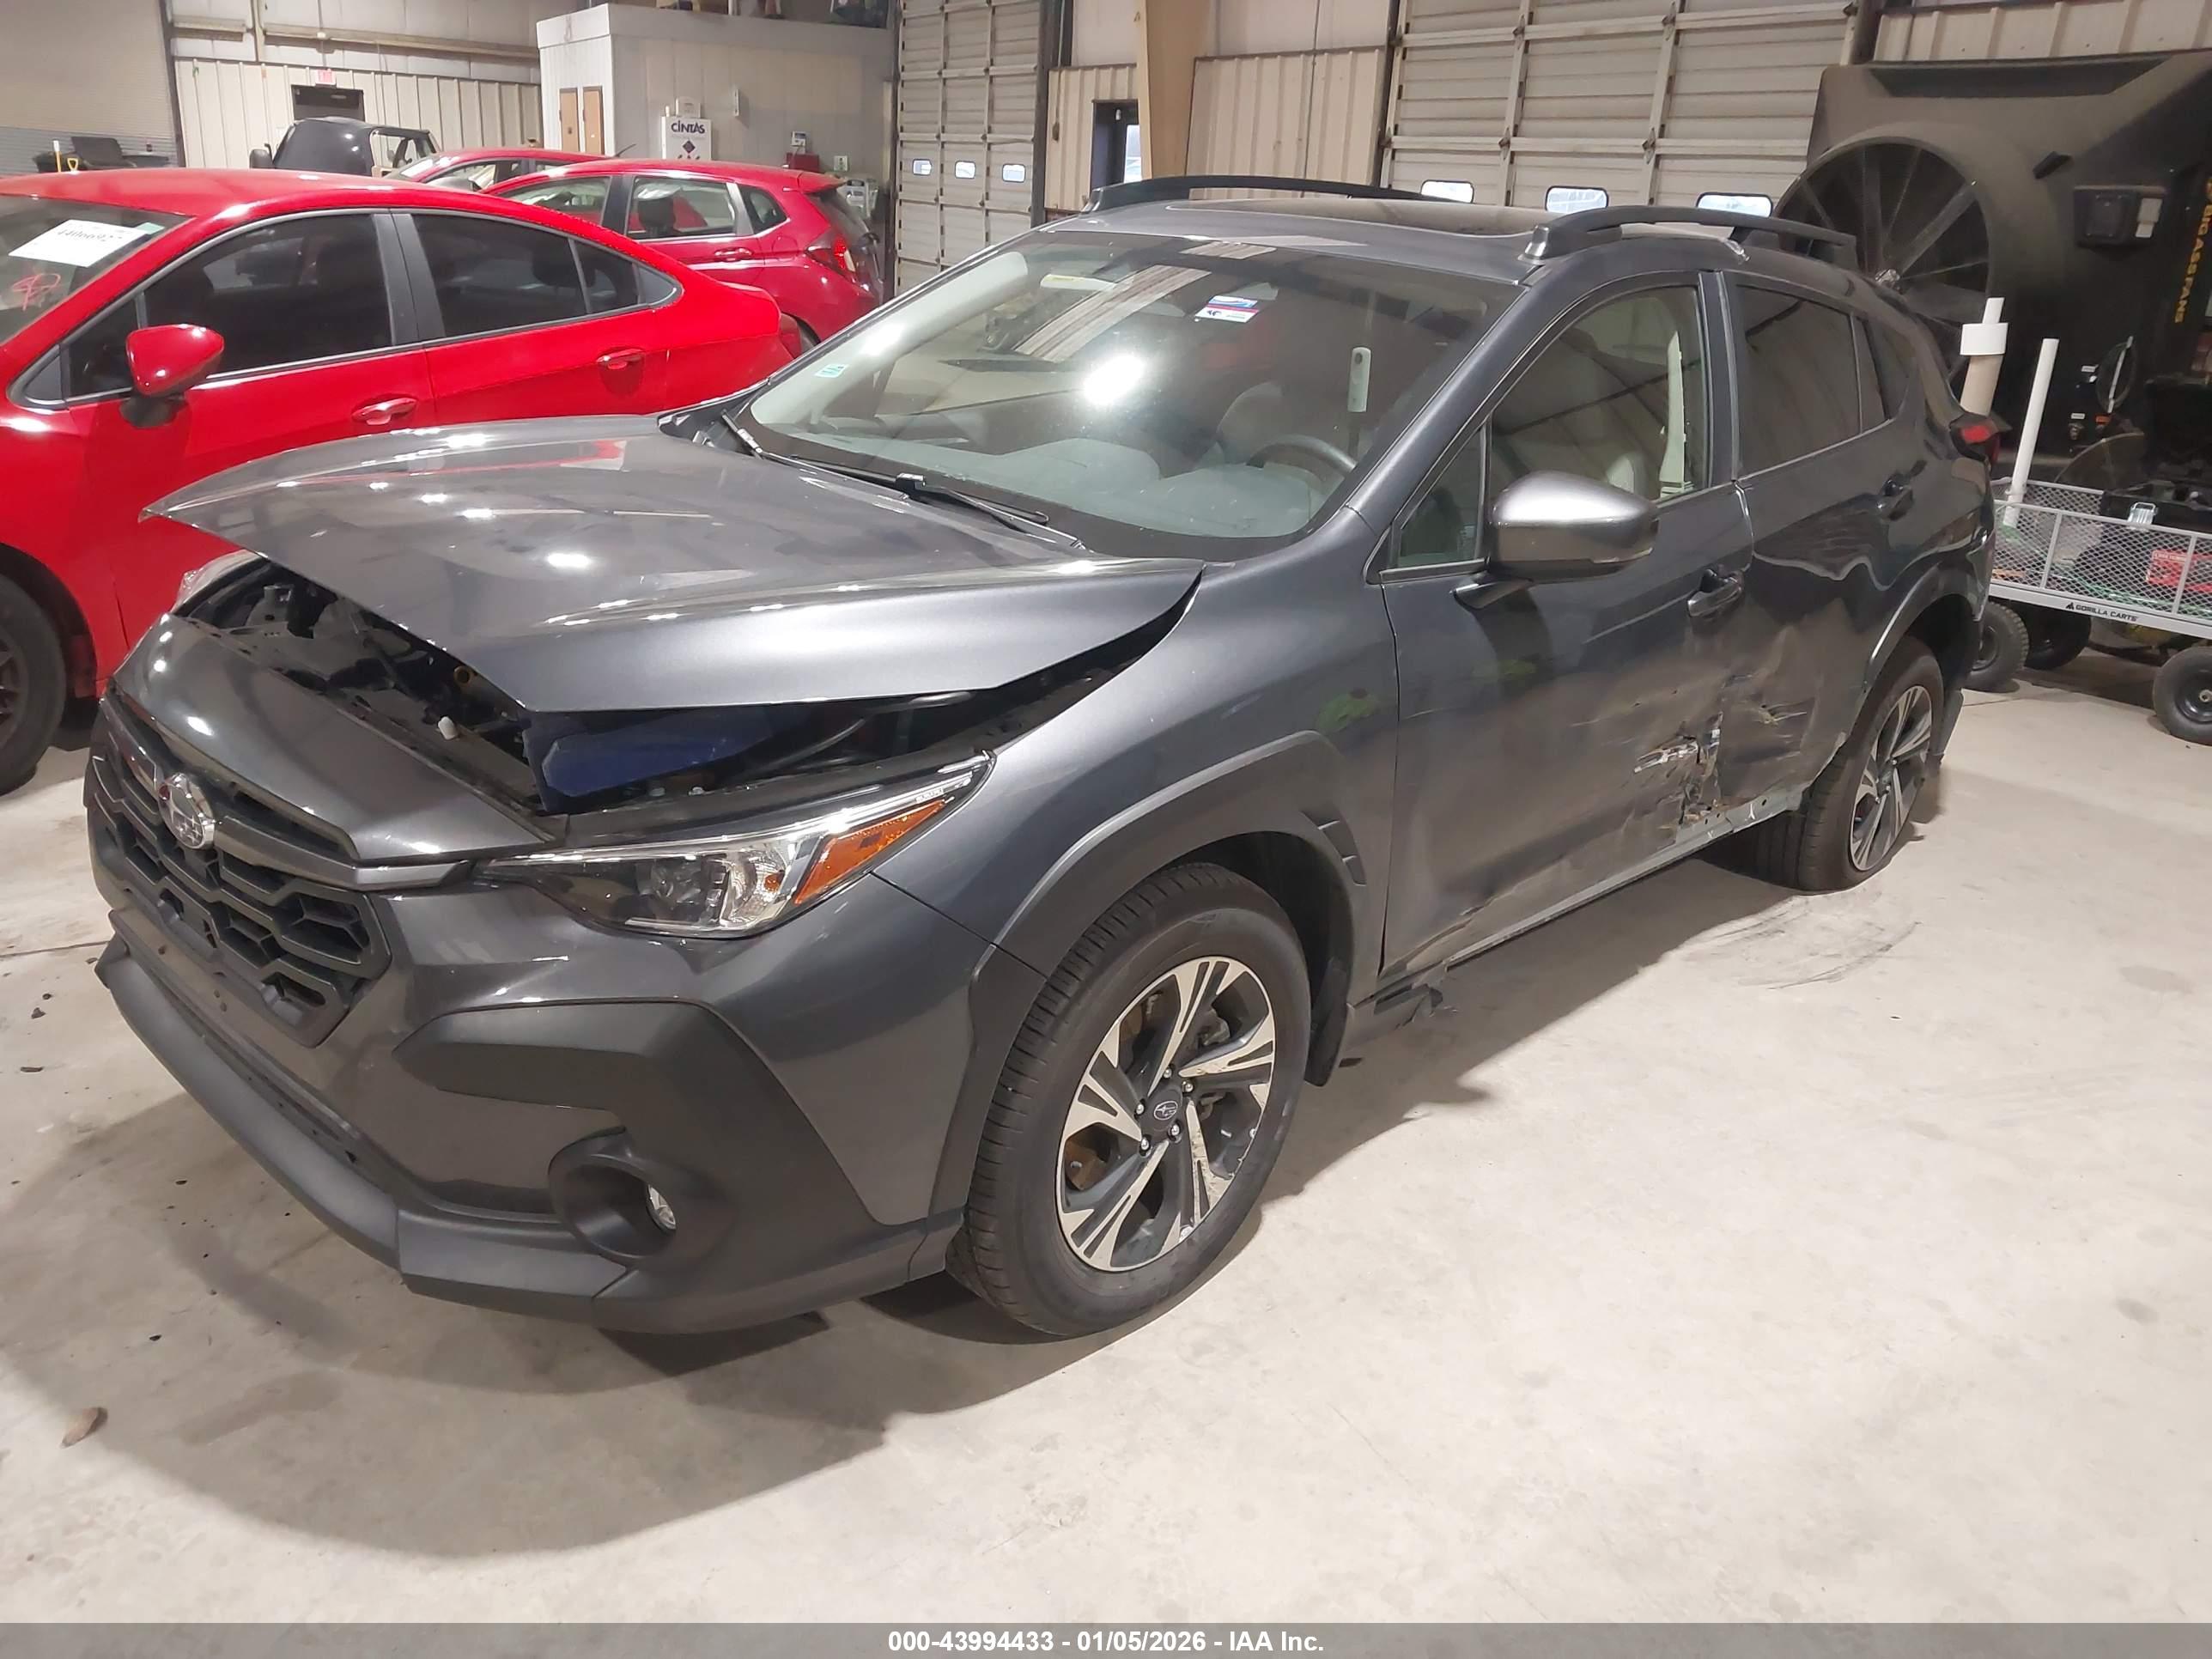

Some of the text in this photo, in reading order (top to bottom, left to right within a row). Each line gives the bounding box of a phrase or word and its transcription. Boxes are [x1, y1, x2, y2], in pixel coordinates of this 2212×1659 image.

[671, 120, 705, 134] CINTAS
[2075, 605, 2137, 622] GORILLA CARTS
